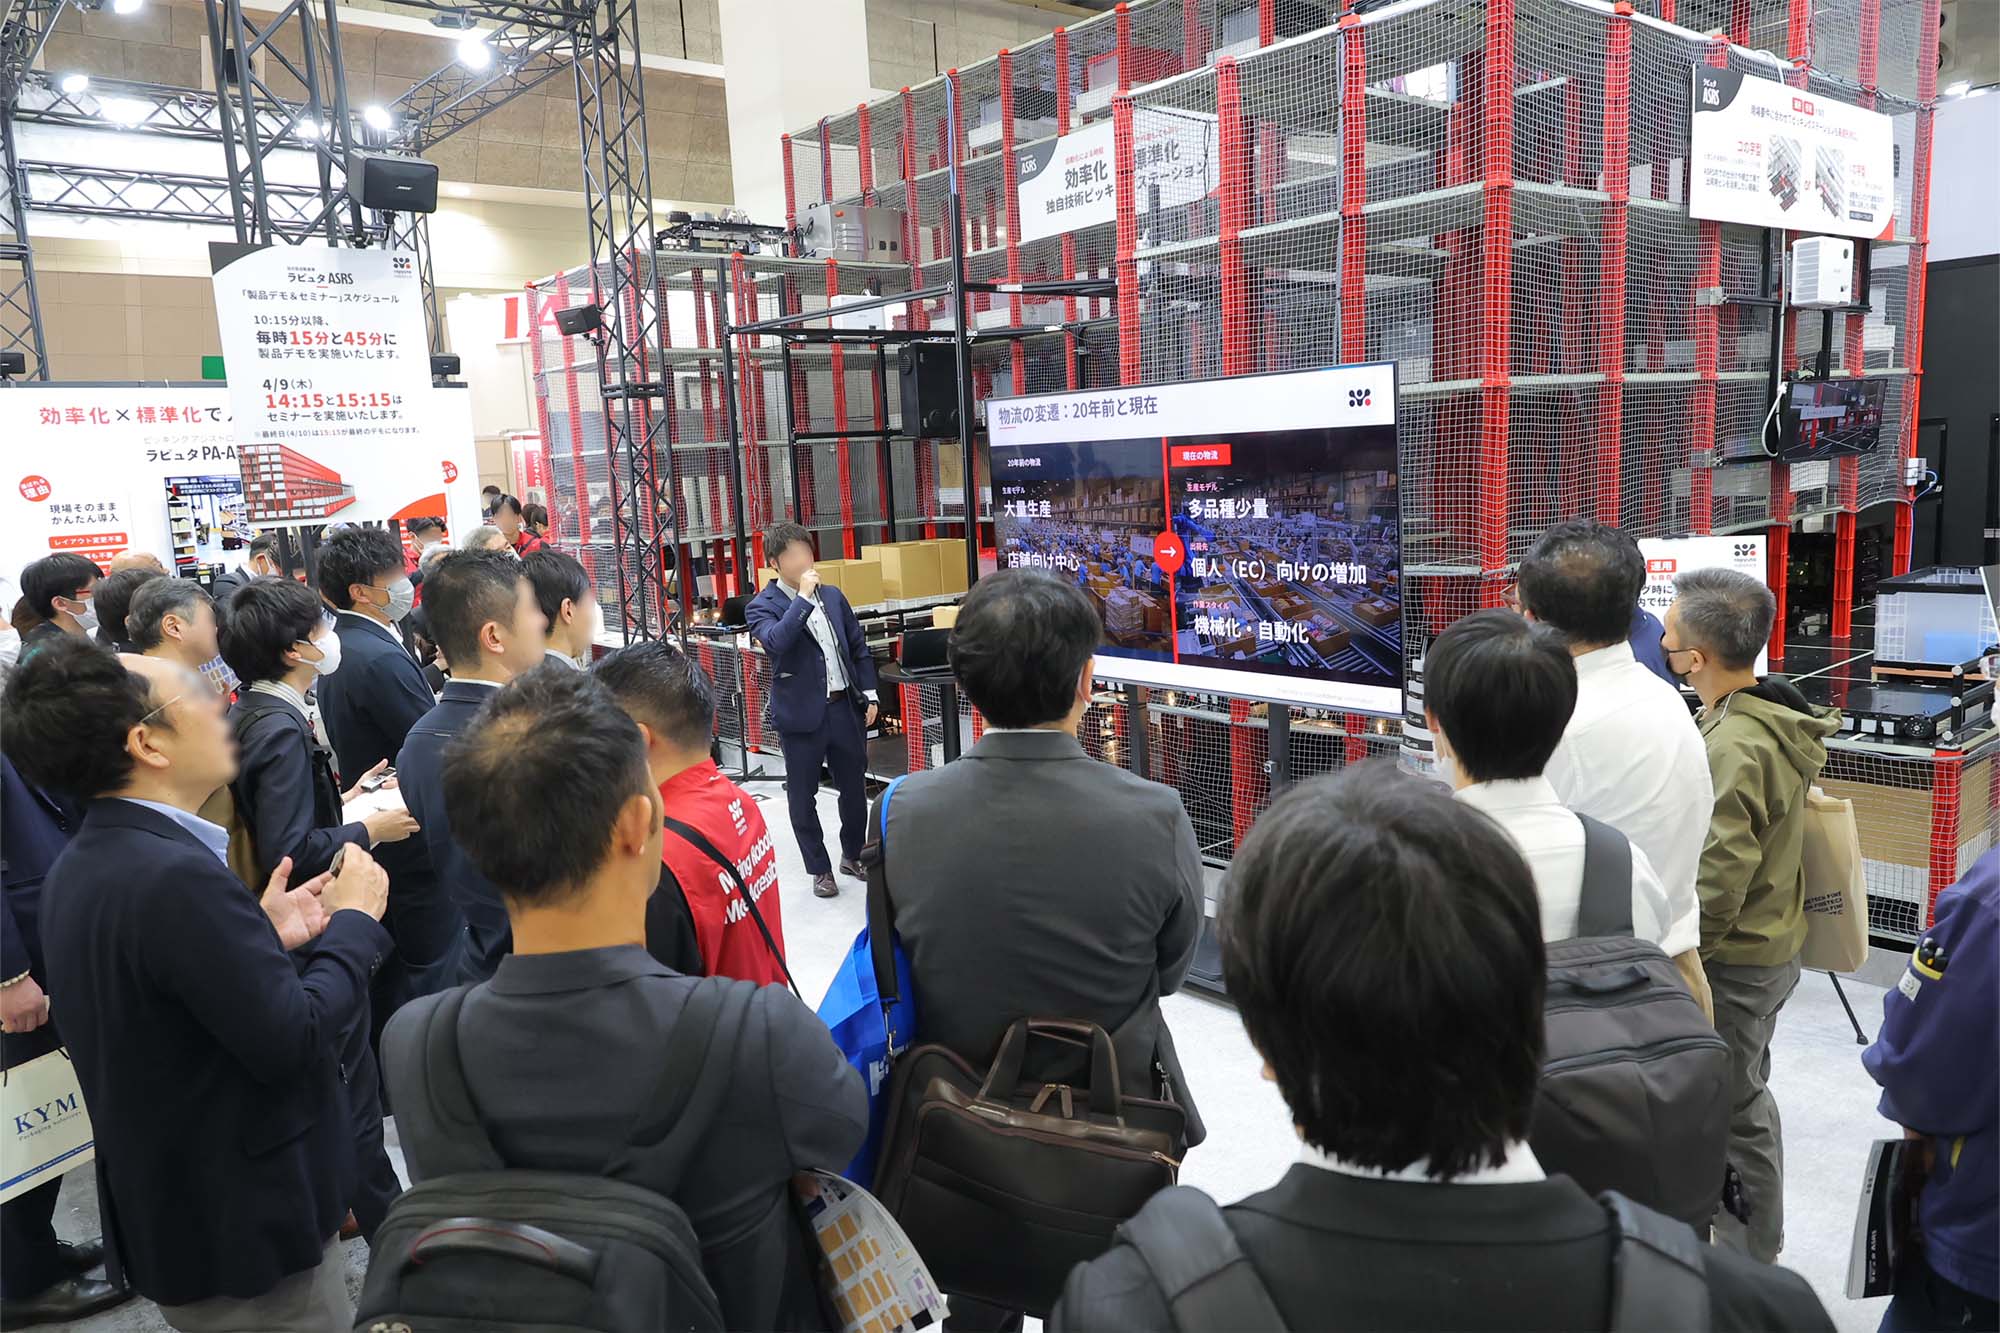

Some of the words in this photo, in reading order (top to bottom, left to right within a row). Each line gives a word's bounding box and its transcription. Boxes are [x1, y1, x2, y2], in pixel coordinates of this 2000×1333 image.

[1703, 87, 1720, 106] ASRS
[1021, 158, 1037, 175] ASRS
[1065, 159, 1109, 190] 効率化
[1046, 184, 1115, 215] 独自技術ピッキ
[328, 272, 354, 285] ASRS
[256, 330, 398, 346] 毎時15分と45分に
[258, 348, 400, 360] 製品デモを実施いたします。
[265, 393, 403, 409] 14:15と15:15は
[267, 410, 403, 423] セミナーを実施いたします。
[202, 445, 236, 460] PA-A
[1182, 450, 1219, 461] 現在の物流
[23, 485, 50, 499] 理由
[50, 502, 117, 514] 現場そのまま
[1003, 499, 1052, 518] 大量生産
[1189, 498, 1269, 519] 多品種少量
[52, 513, 119, 525] かんたん導入
[1008, 551, 1080, 572] 店舗向け中心
[1650, 560, 1673, 572] 運用
[1194, 615, 1311, 645] 機械化・自動化
[14, 1092, 78, 1135] KYM
